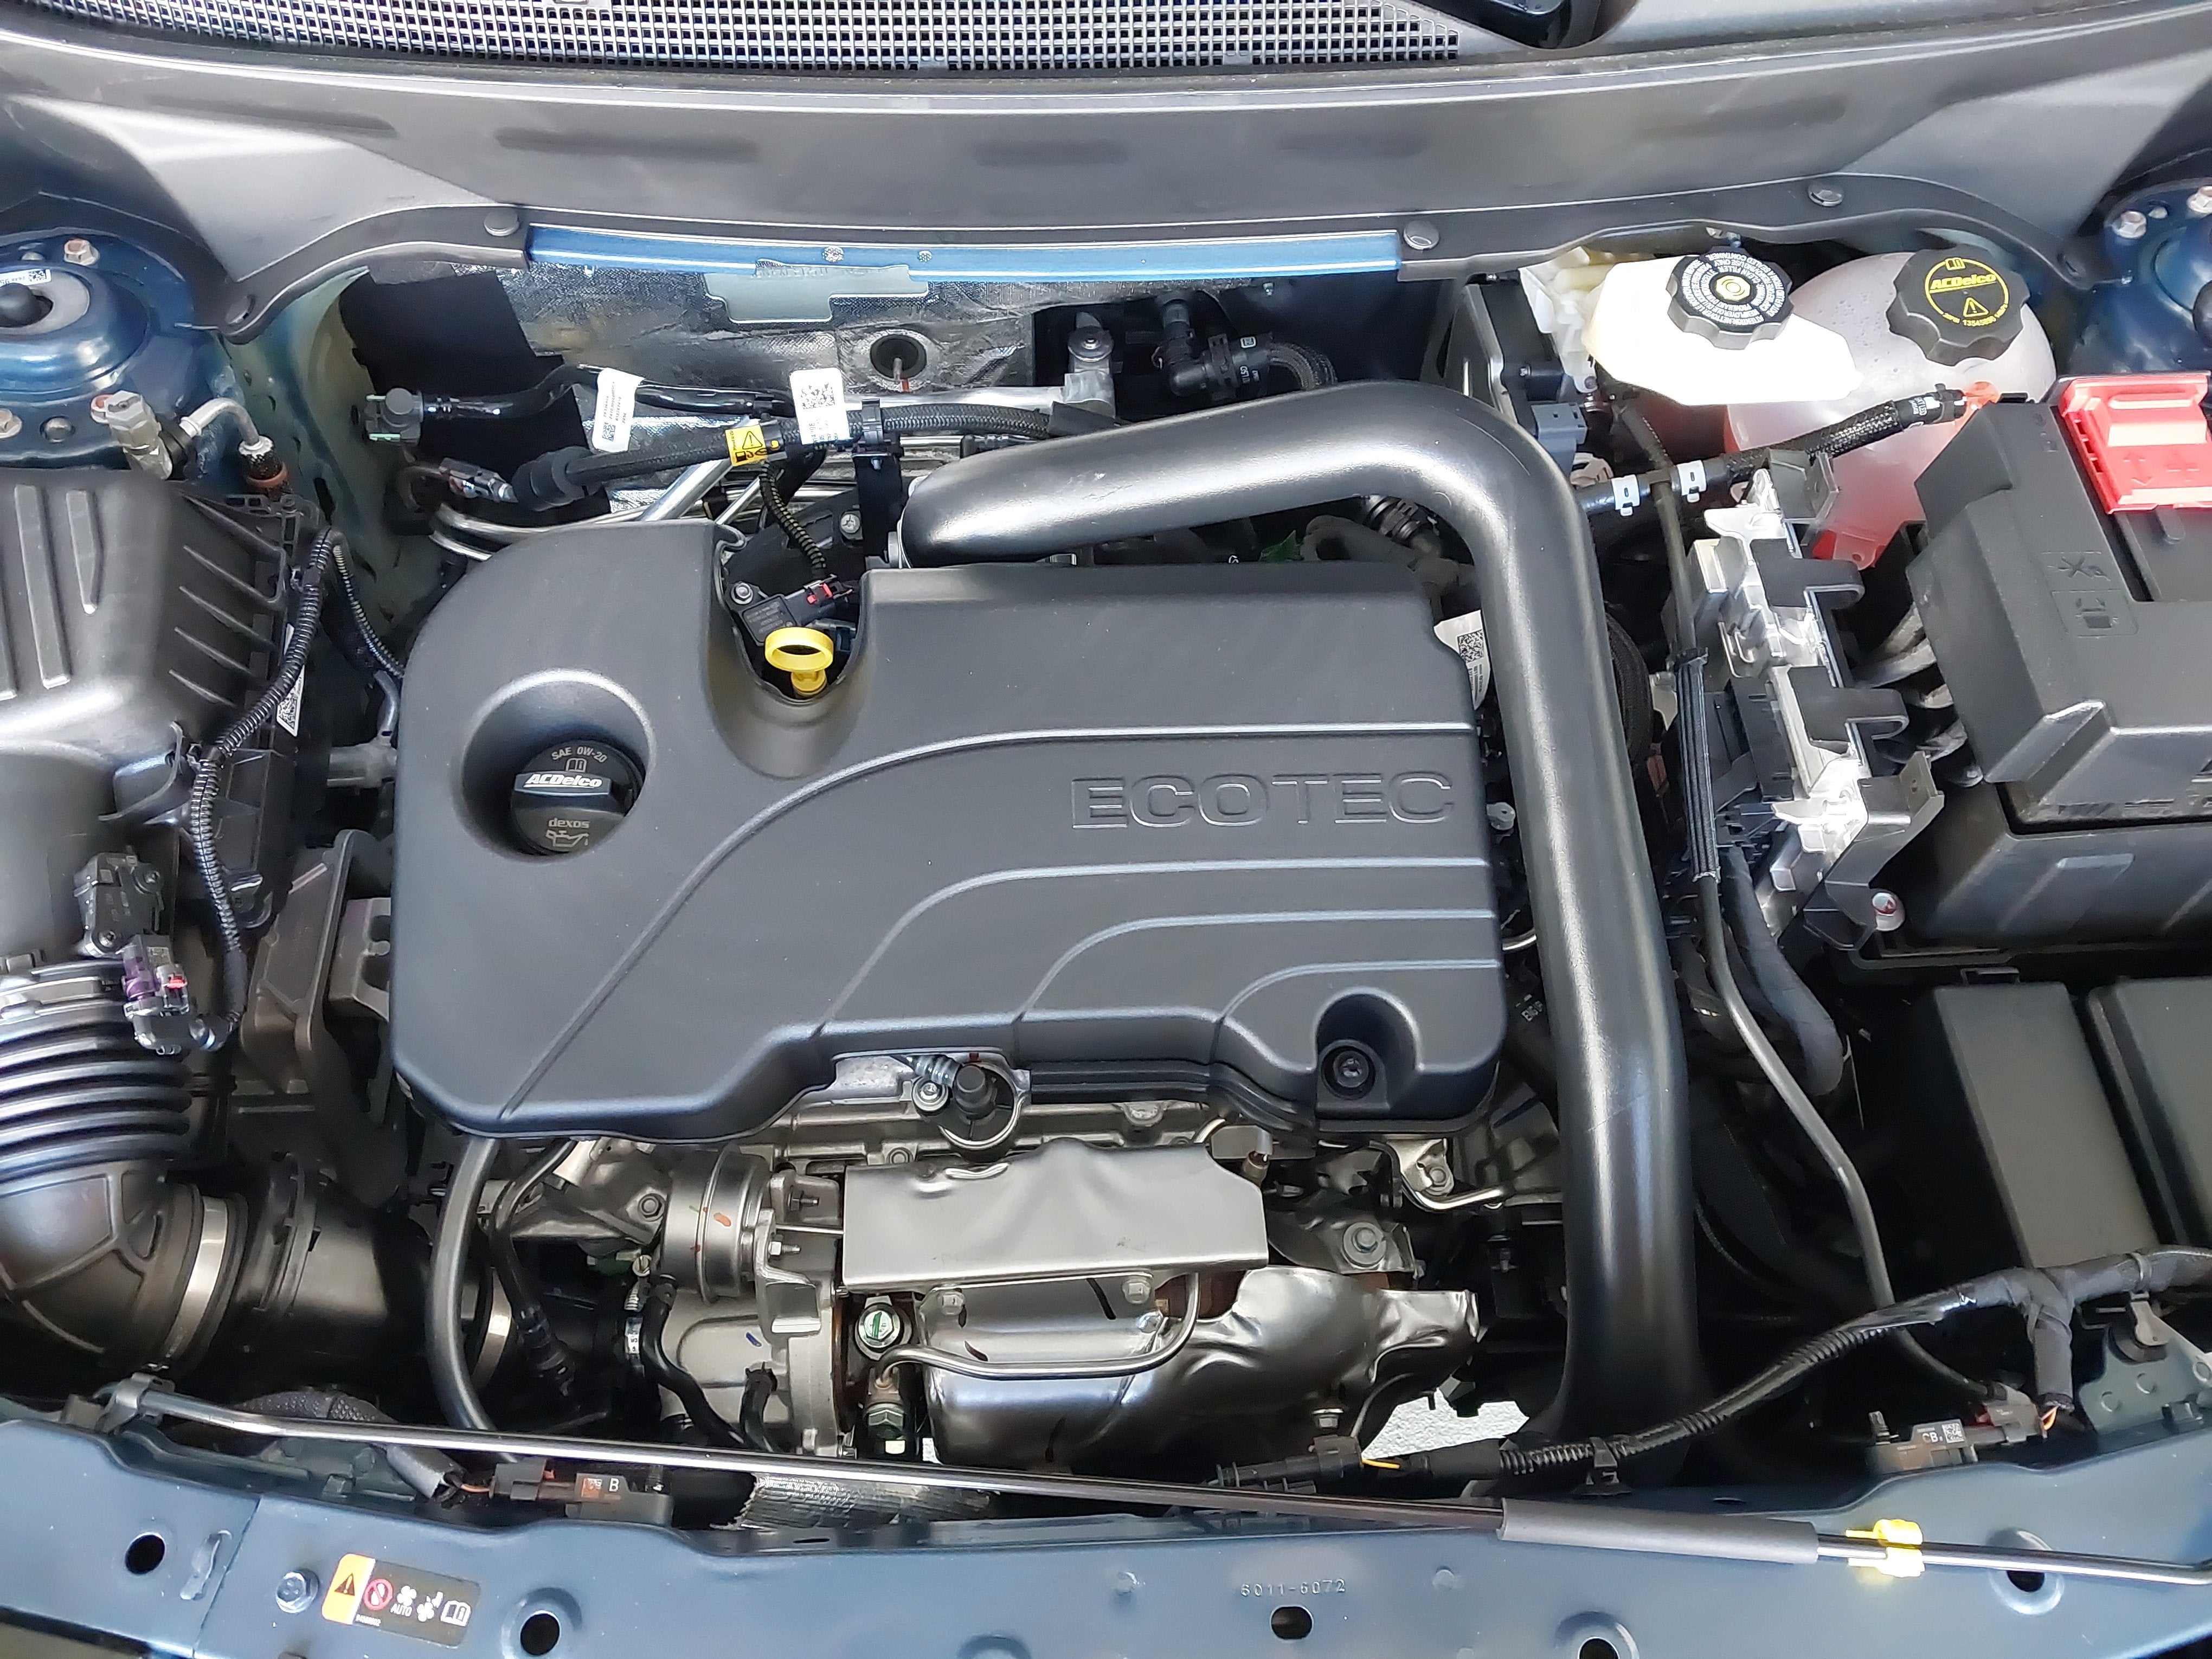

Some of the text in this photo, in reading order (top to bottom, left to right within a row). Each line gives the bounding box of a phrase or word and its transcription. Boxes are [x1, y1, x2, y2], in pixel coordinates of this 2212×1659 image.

[1731, 259, 1745, 268] USE
[1740, 268, 1761, 283] CLEAN
[1930, 274, 1997, 291] ACDelco
[551, 745, 608, 763] SAE 0W-20
[524, 774, 603, 788] ACDelco
[1071, 770, 1455, 829] ECOTEC
[548, 817, 590, 829] dexos
[1240, 1578, 1346, 1597] 6011-6072
[390, 1603, 413, 1617] AUTO
